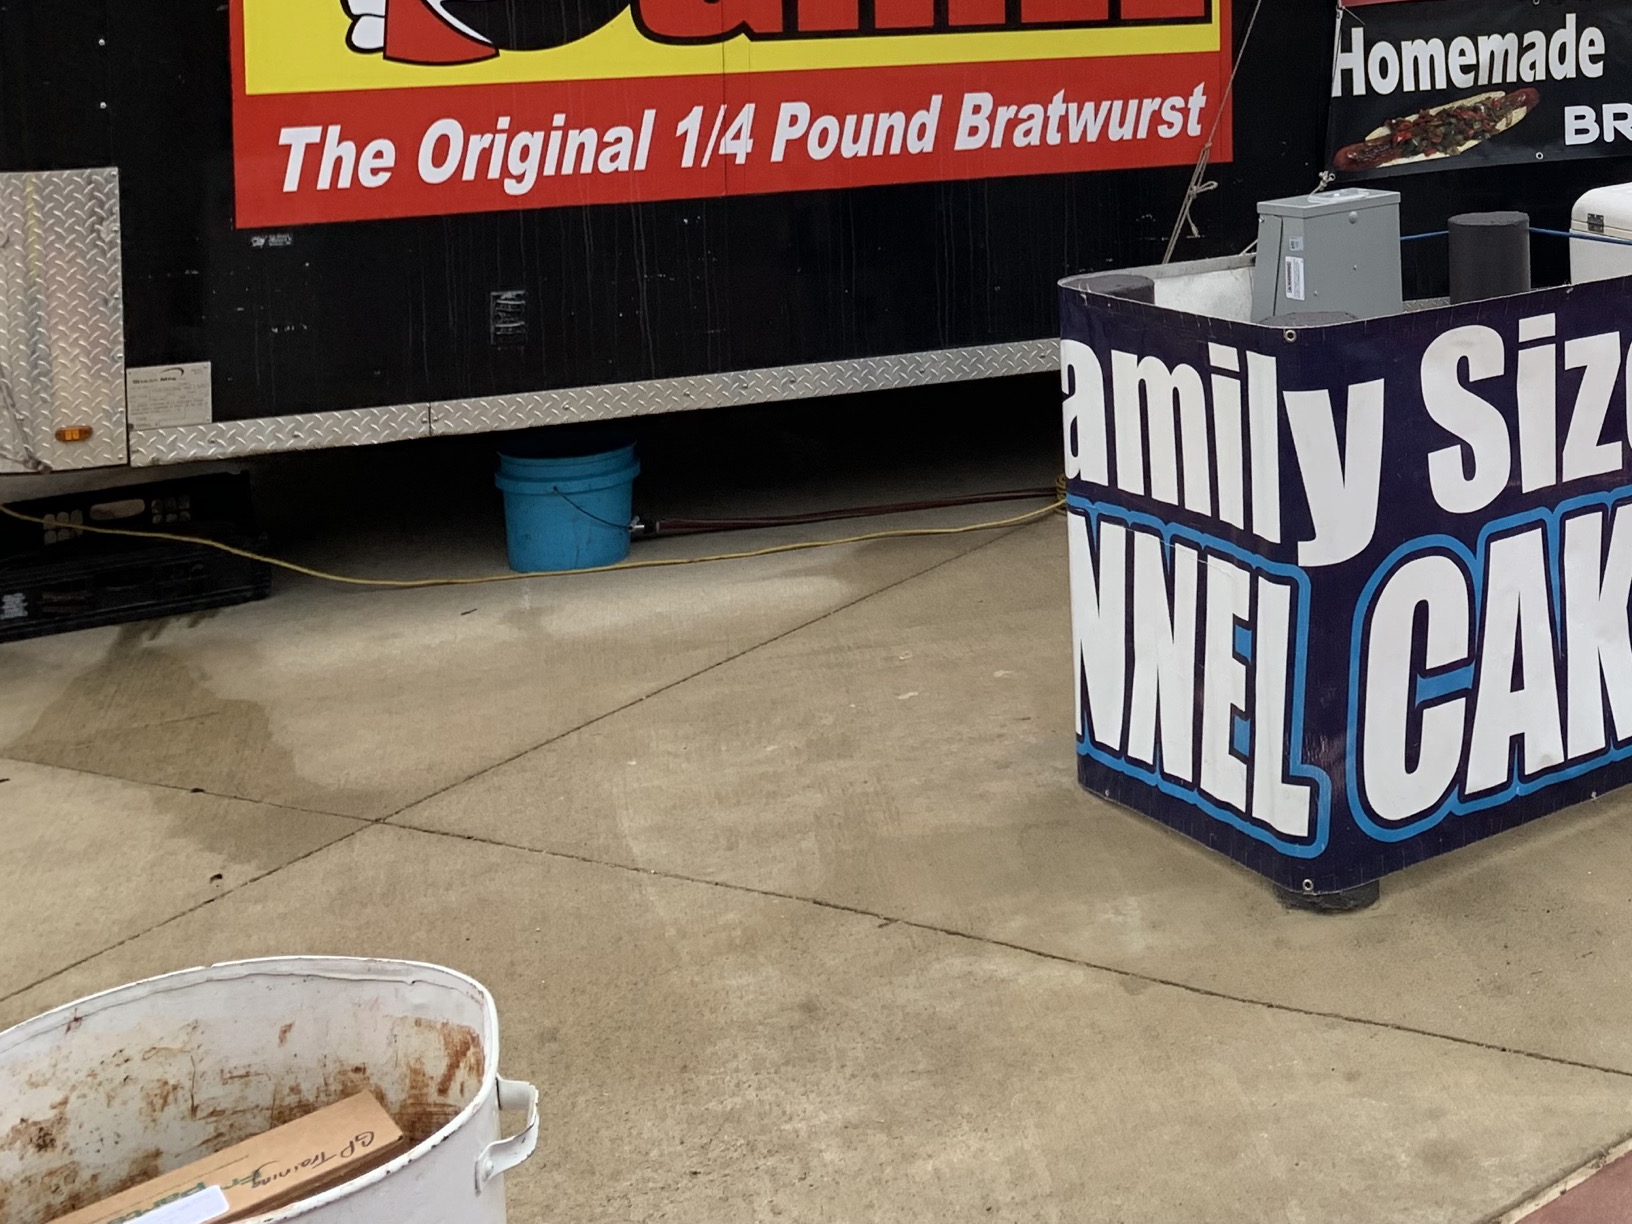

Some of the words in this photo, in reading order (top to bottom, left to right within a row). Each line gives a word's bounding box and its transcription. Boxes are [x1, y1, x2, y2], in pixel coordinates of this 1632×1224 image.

[1331, 13, 1605, 98] Homemade
[277, 125, 397, 194] The
[417, 109, 657, 196] Original
[676, 102, 754, 168] 1/4
[770, 94, 942, 162] Pound
[954, 81, 1207, 149] Bratwurst
